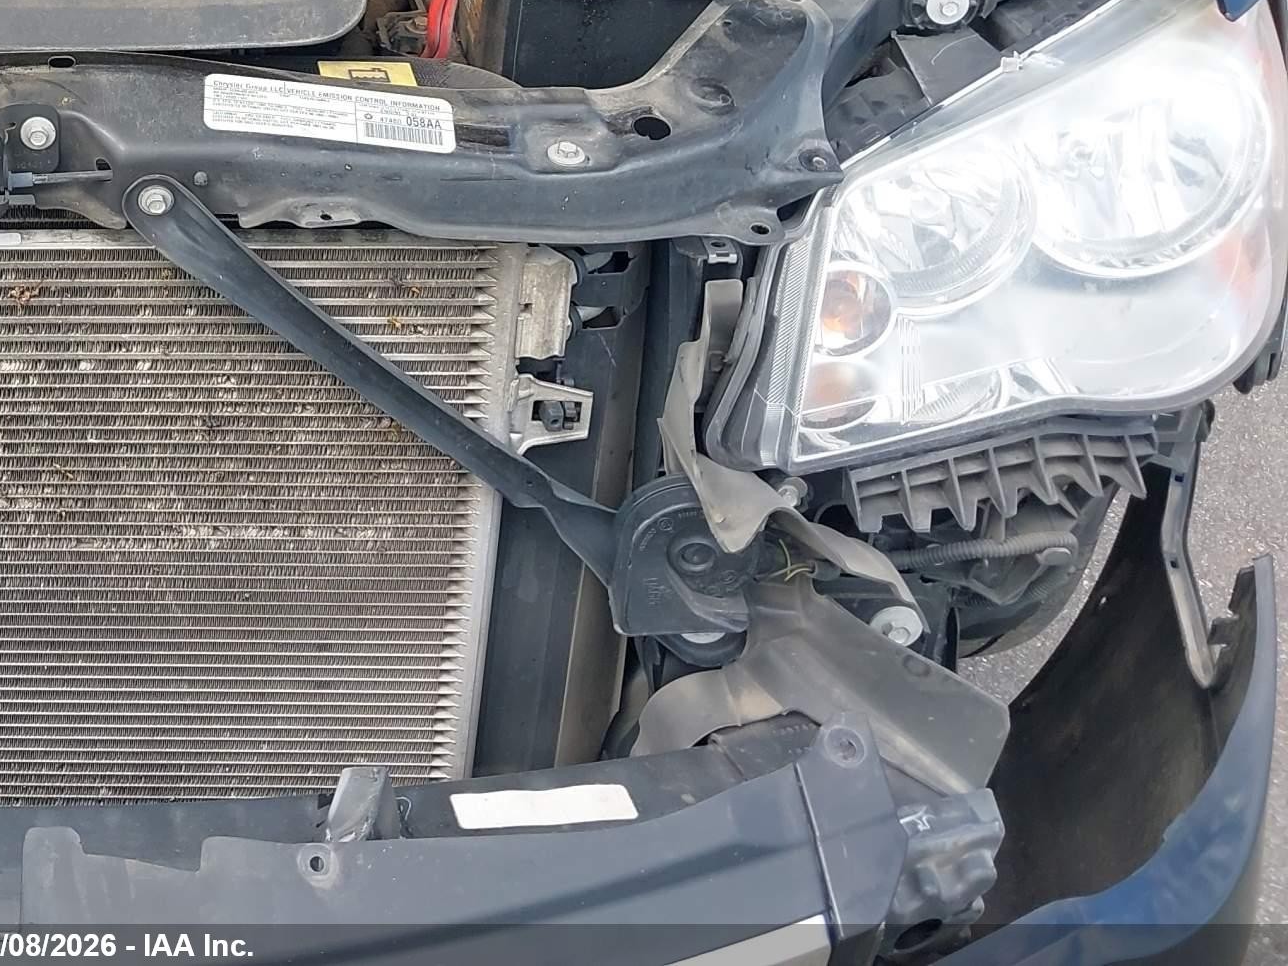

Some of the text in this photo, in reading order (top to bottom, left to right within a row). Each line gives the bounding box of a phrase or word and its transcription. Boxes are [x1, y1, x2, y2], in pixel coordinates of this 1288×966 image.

[318, 91, 353, 101] EMISSION
[355, 96, 388, 106] CONTROL
[390, 100, 441, 112] INFORMATION
[406, 116, 442, 130] 058AA
